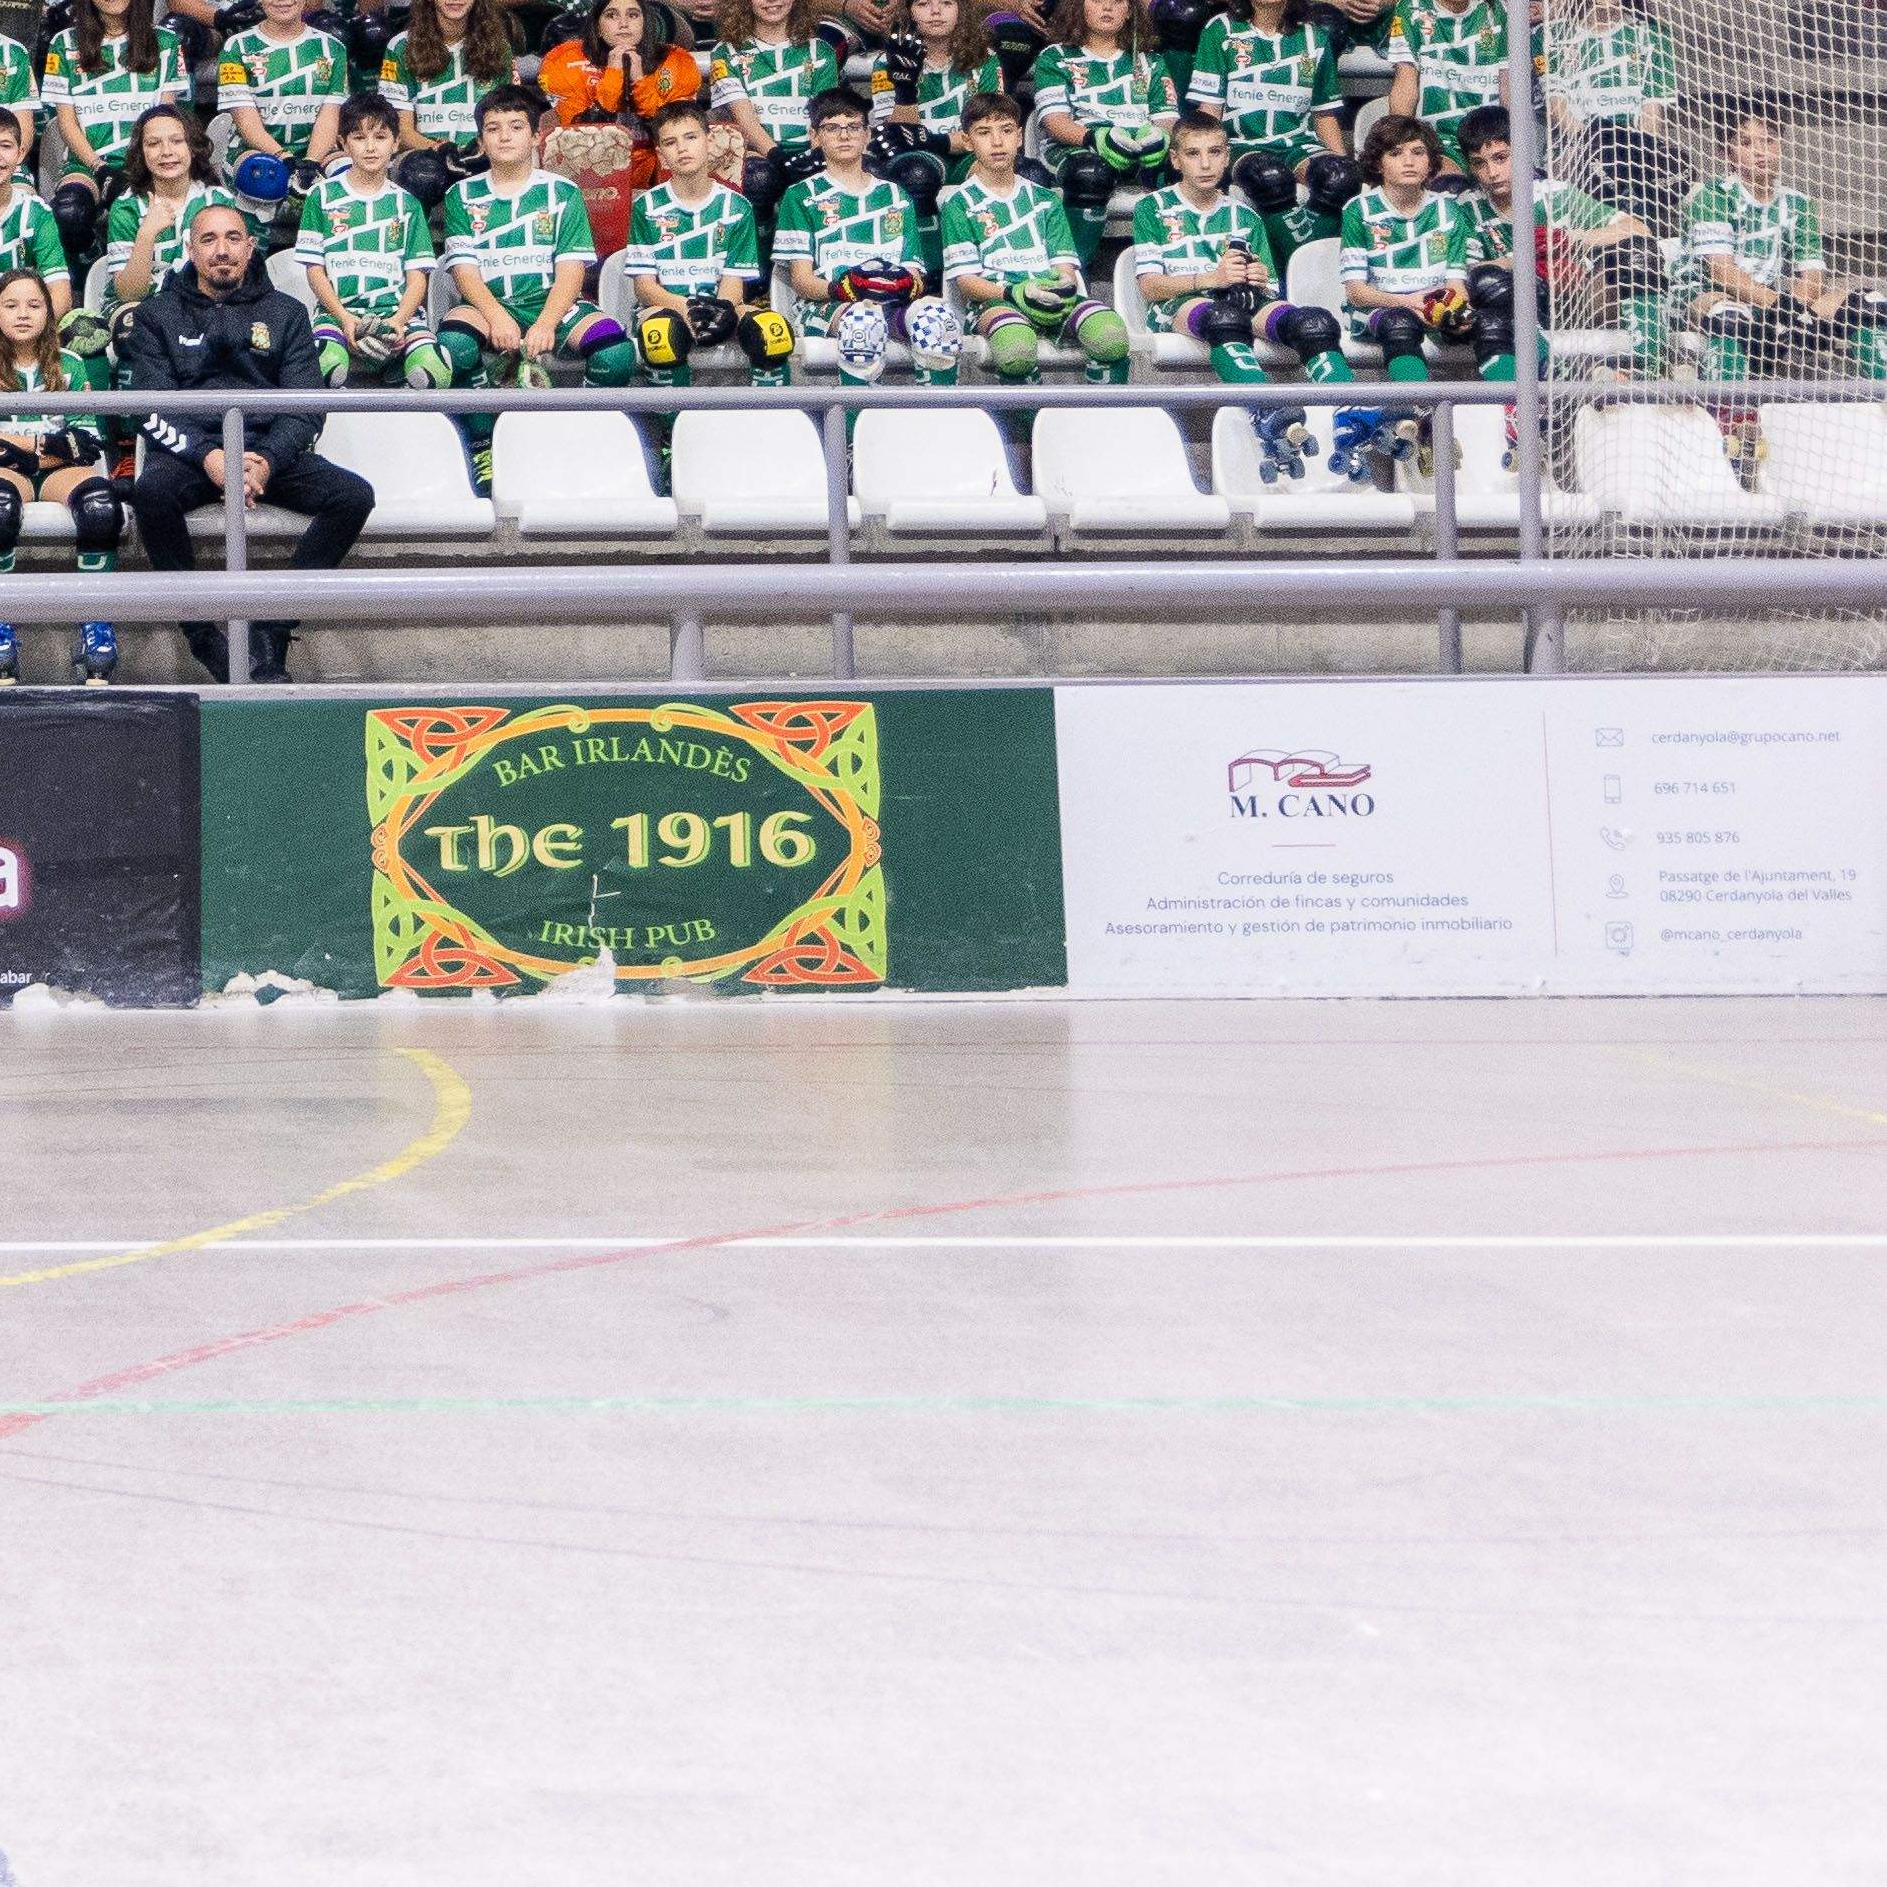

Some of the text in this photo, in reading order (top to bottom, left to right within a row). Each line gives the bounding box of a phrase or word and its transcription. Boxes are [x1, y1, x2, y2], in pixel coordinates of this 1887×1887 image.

[492, 736, 751, 787] BAR IRLANDÈS
[1654, 782, 1736, 795] 696 714 651
[1230, 794, 1375, 819] M. CANO
[611, 810, 816, 870] 1916
[1657, 831, 1740, 844] 935 805 876
[1218, 869, 1394, 889] Correduría de seguros
[1659, 870, 1720, 885] Passatge
[1724, 870, 1740, 883] de
[1841, 869, 1857, 882] 19
[1147, 894, 1469, 911] Administración de fincas y comunidades
[1660, 890, 1701, 903] 08290
[1706, 890, 1784, 905] Cerdanyola
[1787, 889, 1808, 901] del
[539, 917, 716, 950] IRISH PUB
[1105, 917, 1513, 938] Asesoramiento y gestión de patrimonio inmobiliario
